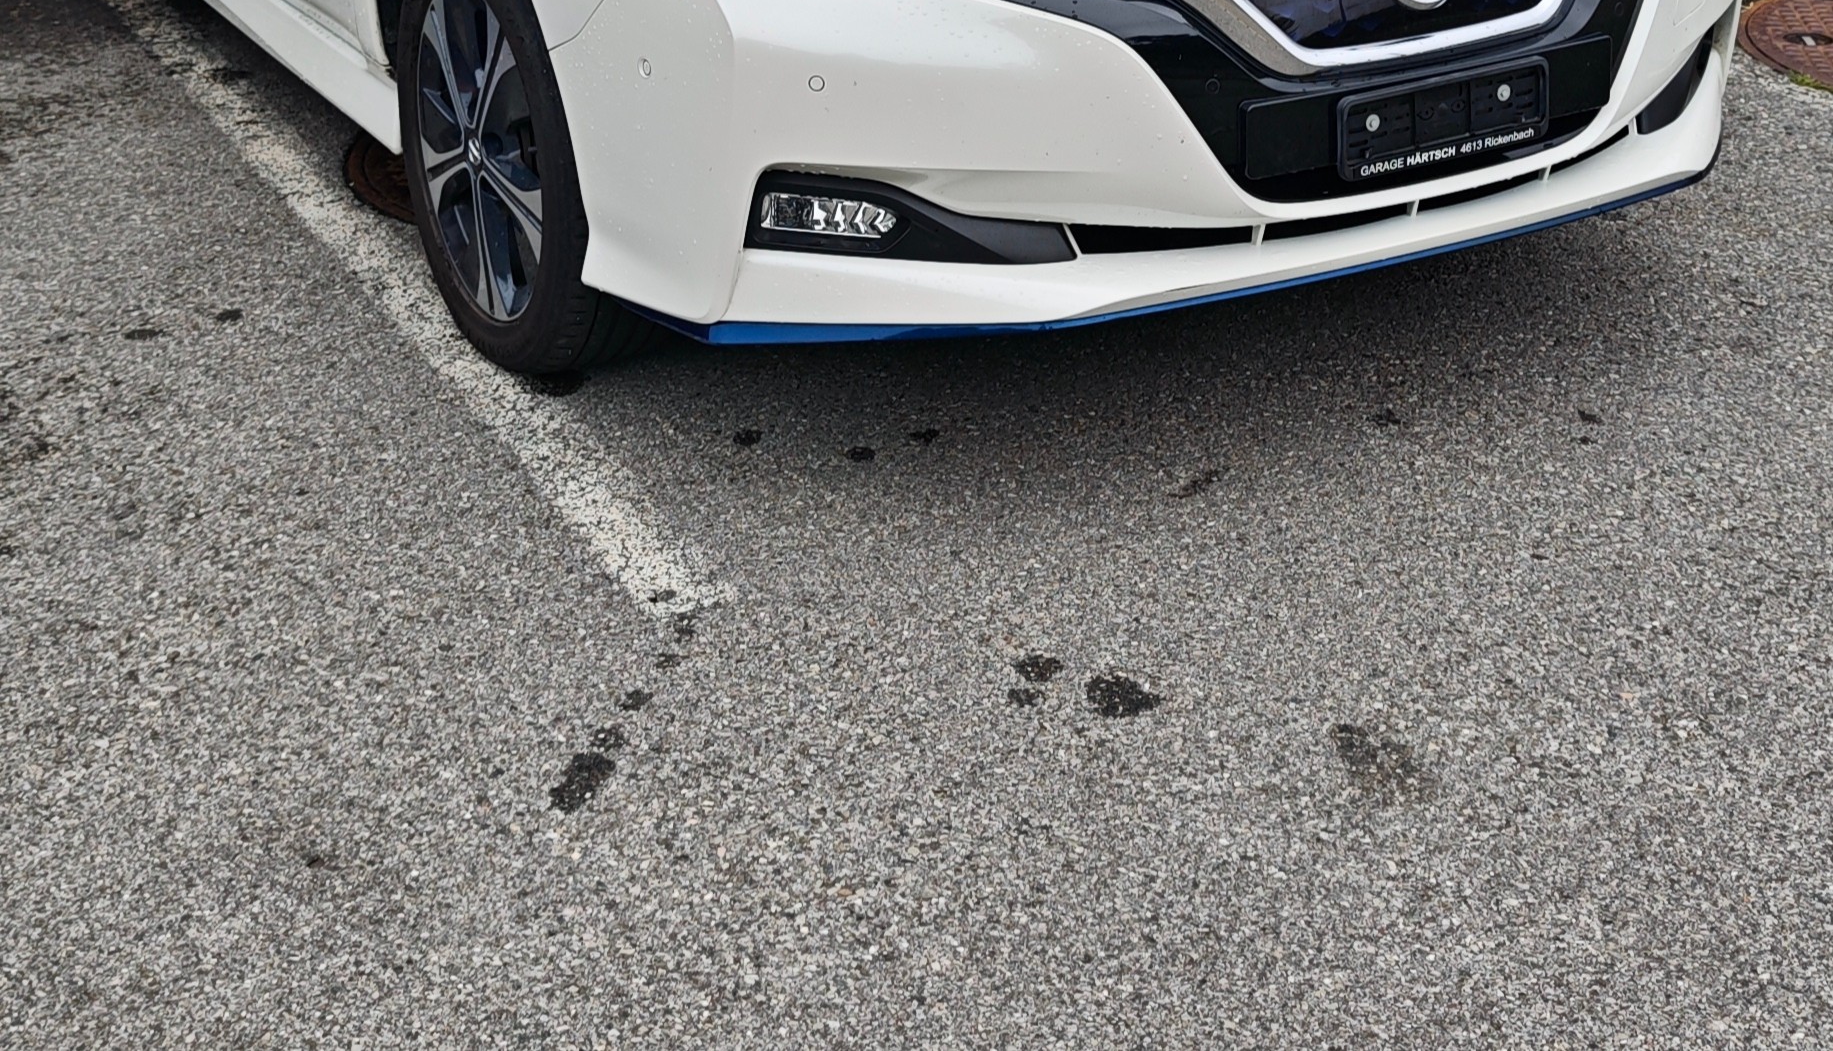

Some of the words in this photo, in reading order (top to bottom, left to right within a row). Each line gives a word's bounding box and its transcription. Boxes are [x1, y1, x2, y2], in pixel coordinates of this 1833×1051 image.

[1360, 157, 1405, 177] GARAGE
[1406, 145, 1456, 167] HÄRTSCH
[1460, 139, 1483, 154] 4613
[1485, 128, 1534, 148] Rickenbach
